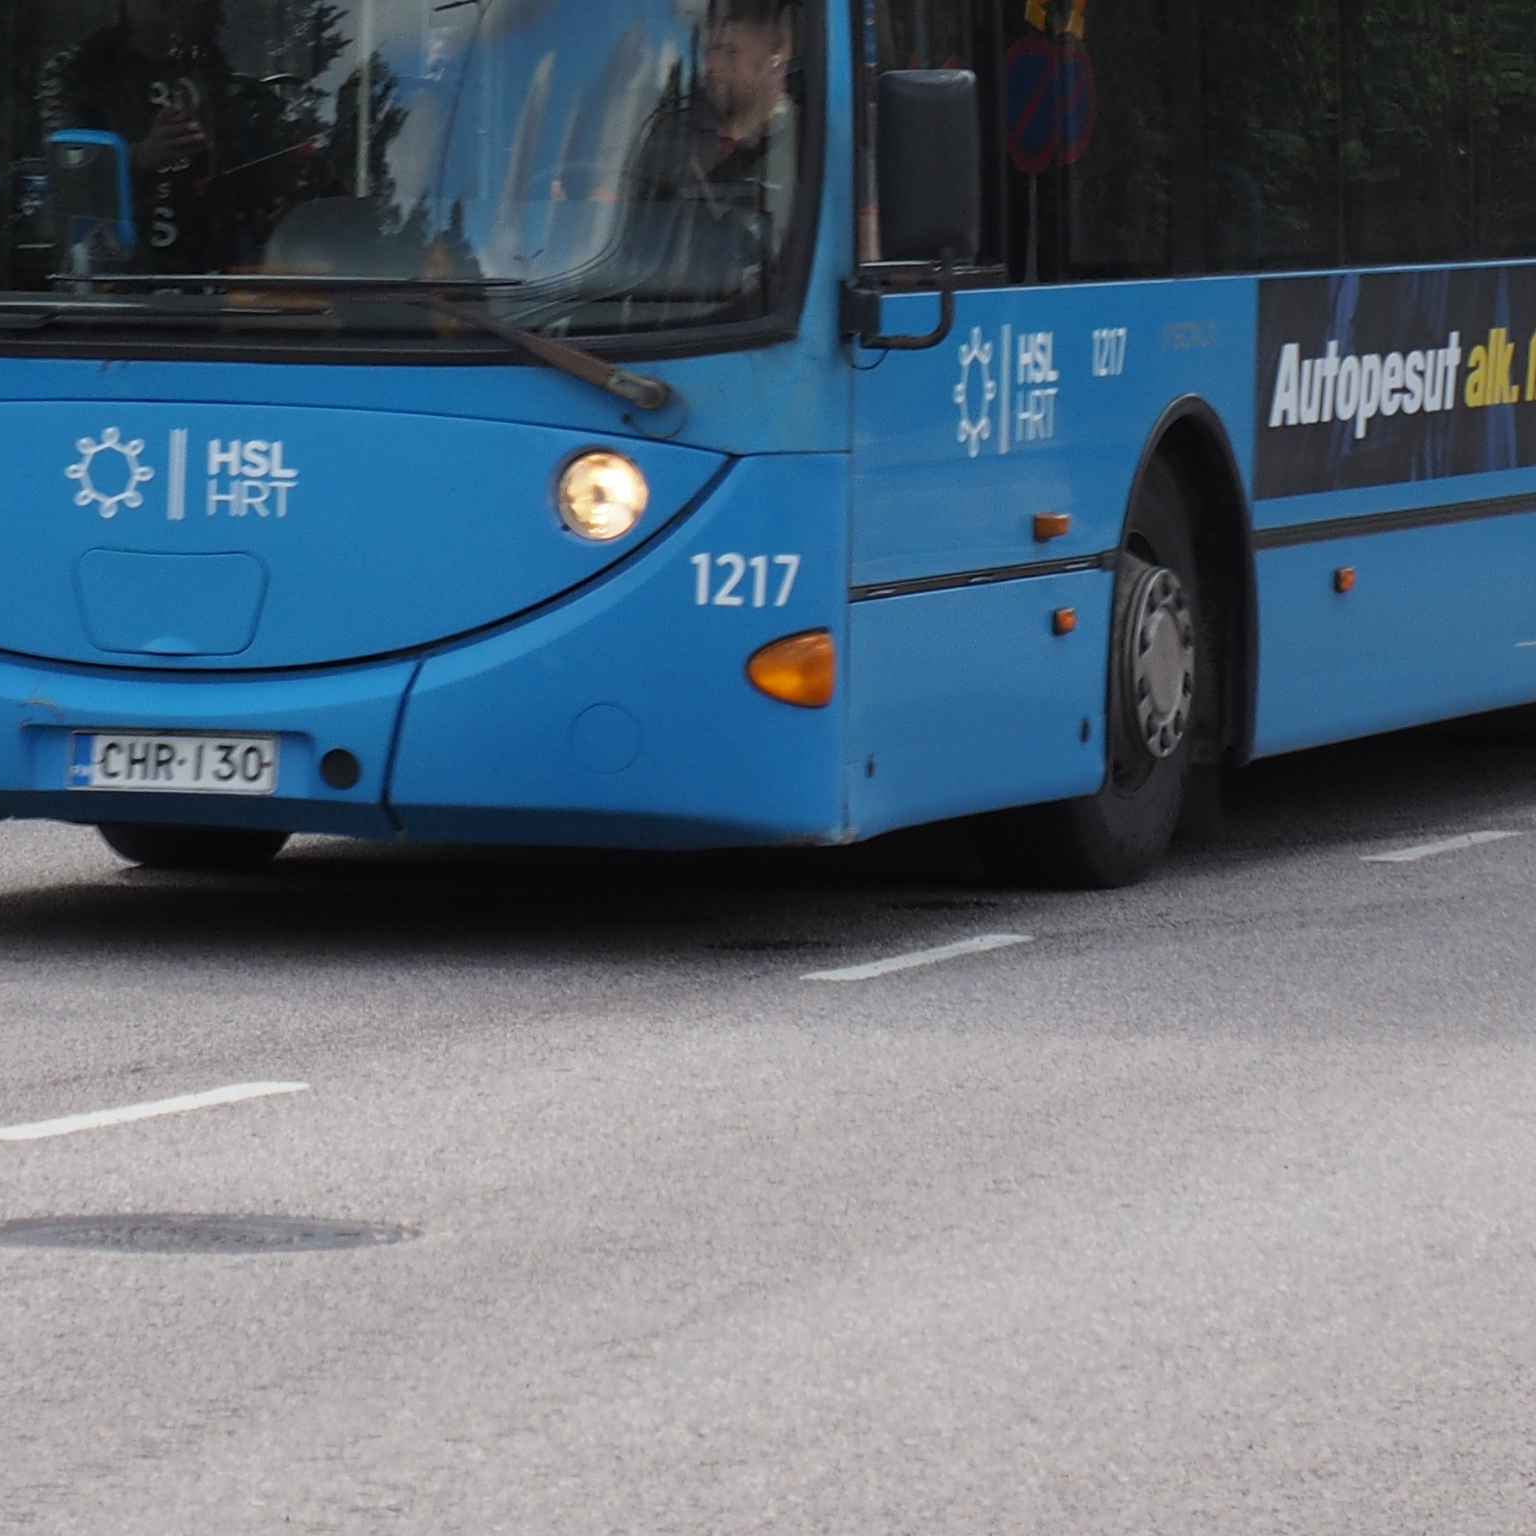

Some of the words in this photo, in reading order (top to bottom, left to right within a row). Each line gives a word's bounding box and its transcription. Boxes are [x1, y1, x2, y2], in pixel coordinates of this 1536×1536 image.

[1017, 331, 1060, 385] HSL
[1268, 330, 1462, 440] Autopesut
[1464, 327, 1520, 408] alk.
[206, 438, 301, 478] HSL
[206, 478, 301, 518] HRT
[690, 552, 802, 608] 1217
[99, 742, 267, 782] CHR-130
